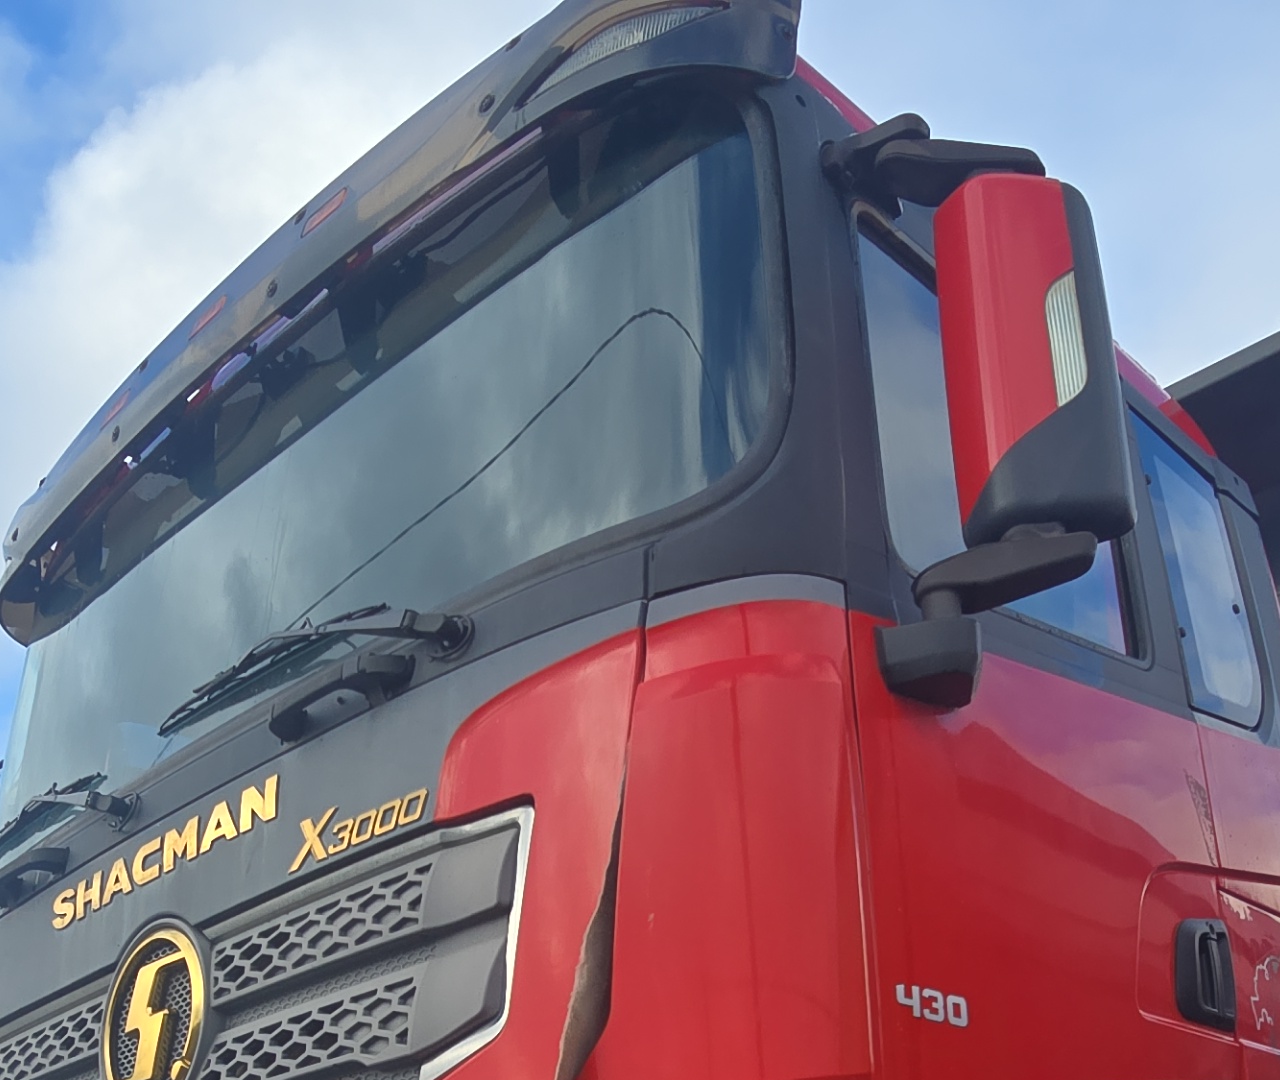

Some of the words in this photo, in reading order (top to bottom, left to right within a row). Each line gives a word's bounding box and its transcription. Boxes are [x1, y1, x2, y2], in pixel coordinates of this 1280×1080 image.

[51, 773, 279, 930] SHACMAN
[288, 788, 429, 876] X3000
[895, 983, 969, 1027] 430
